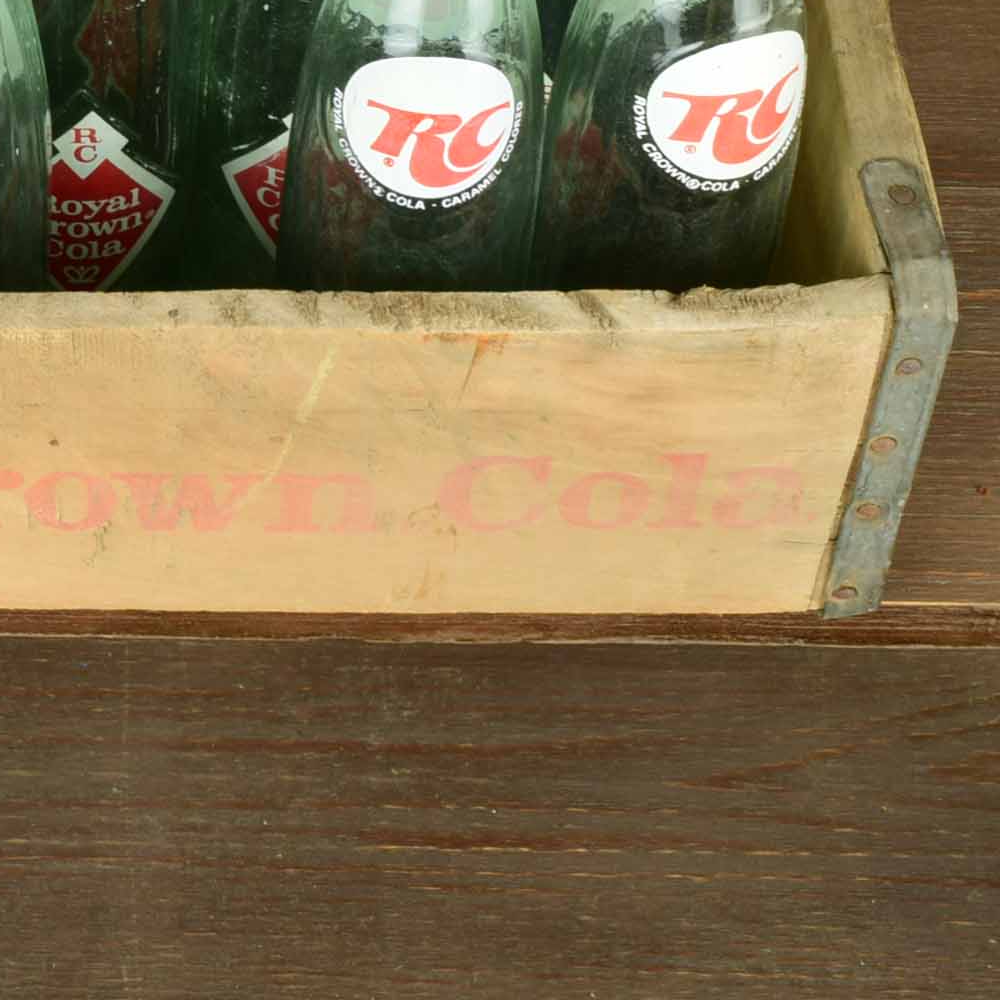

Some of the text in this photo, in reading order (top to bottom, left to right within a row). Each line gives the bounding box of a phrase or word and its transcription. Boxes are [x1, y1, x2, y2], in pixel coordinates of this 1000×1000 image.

[332, 87, 345, 139] ROYAL
[339, 138, 377, 192] CROWN
[386, 192, 426, 211] COLA
[441, 167, 503, 209] CARAMEL
[367, 98, 511, 188] RC
[632, 94, 647, 140] ROYAL
[642, 142, 690, 185] CROWN
[699, 179, 741, 193] COLA
[661, 63, 800, 166] RC
[49, 211, 145, 239] rown
[434, 451, 815, 533] Cola
